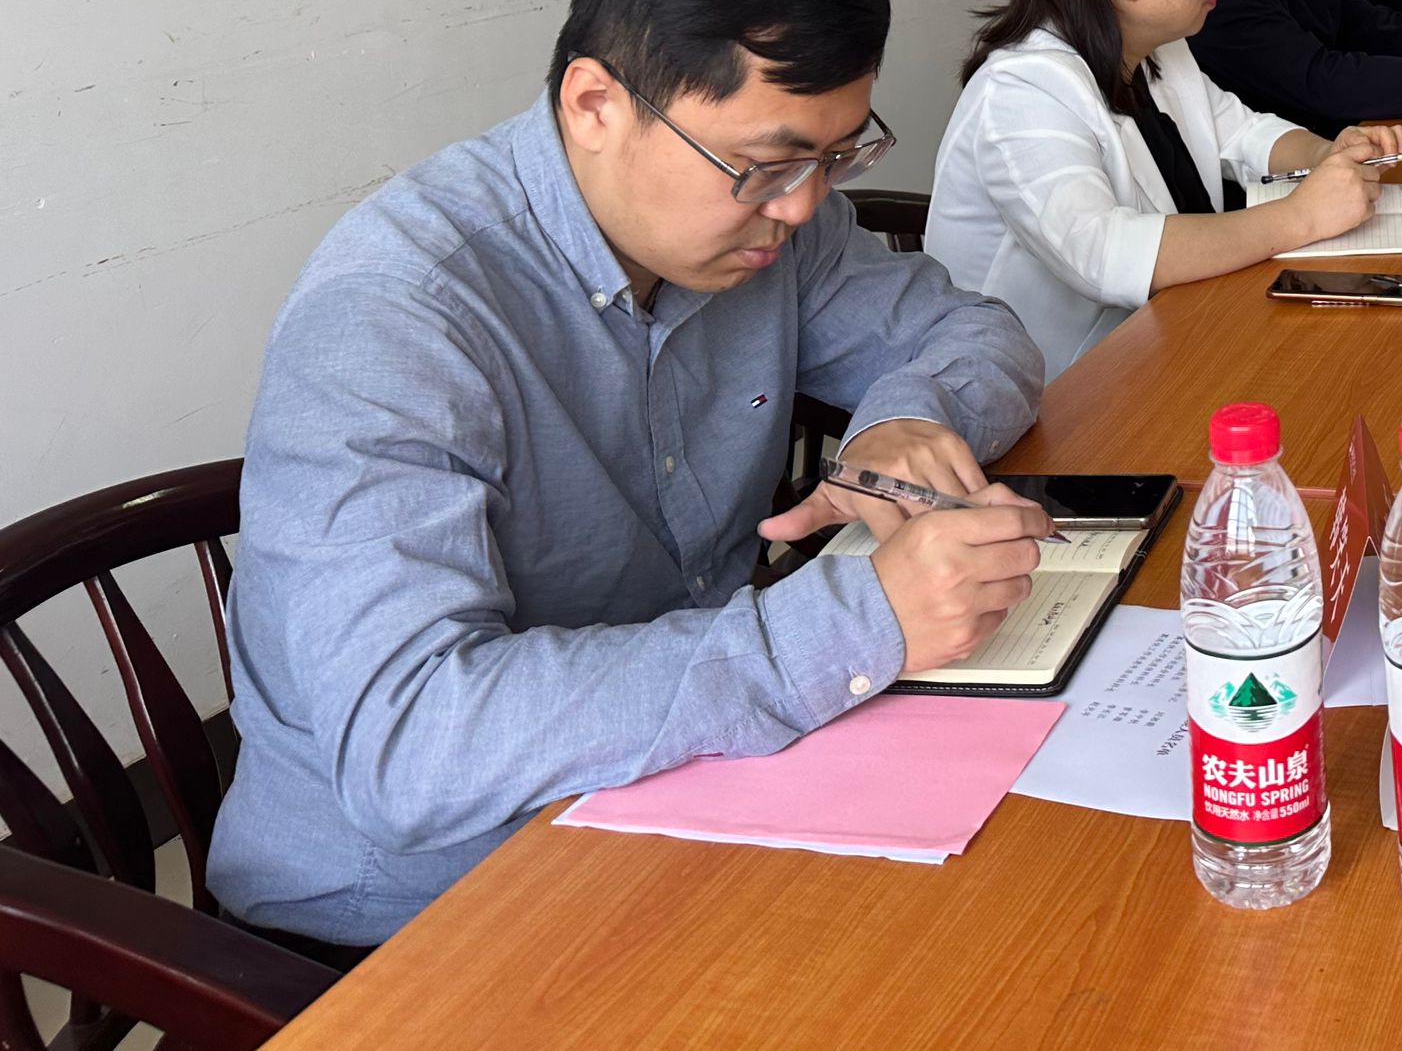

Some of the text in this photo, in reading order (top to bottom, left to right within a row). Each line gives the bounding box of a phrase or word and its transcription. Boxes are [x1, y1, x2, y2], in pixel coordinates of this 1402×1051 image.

[1202, 750, 1308, 789] 农夫山泉
[1204, 778, 1309, 807] NONGFU SPRING
[1205, 801, 1250, 821] 饮用天然水
